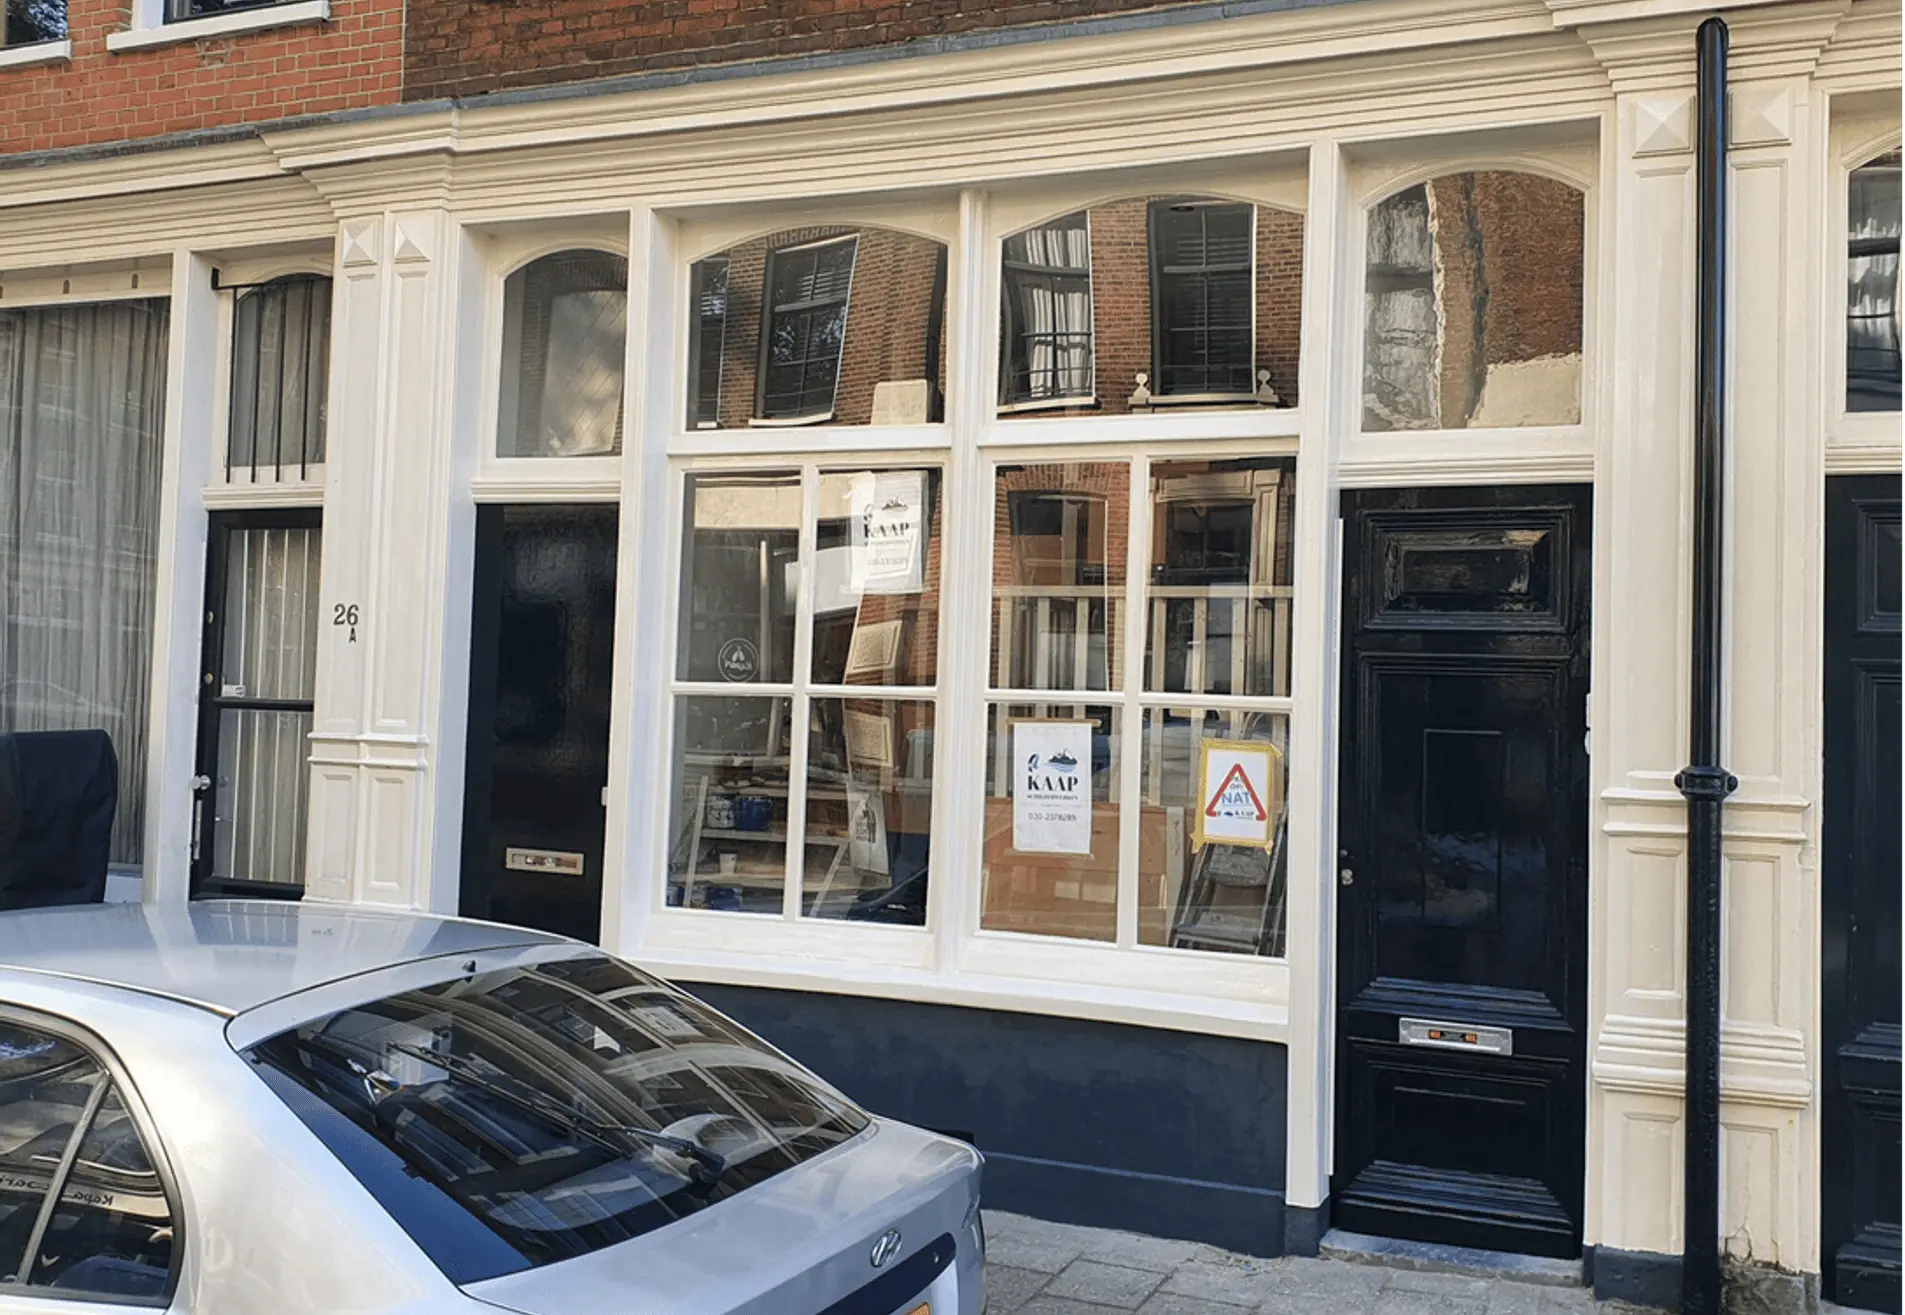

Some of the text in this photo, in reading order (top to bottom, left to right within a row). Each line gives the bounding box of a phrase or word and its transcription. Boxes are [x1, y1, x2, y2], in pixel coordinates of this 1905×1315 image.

[333, 603, 359, 626] 26
[348, 627, 357, 643] A
[1027, 775, 1079, 791] KAAP
[1221, 792, 1251, 804] NAT
